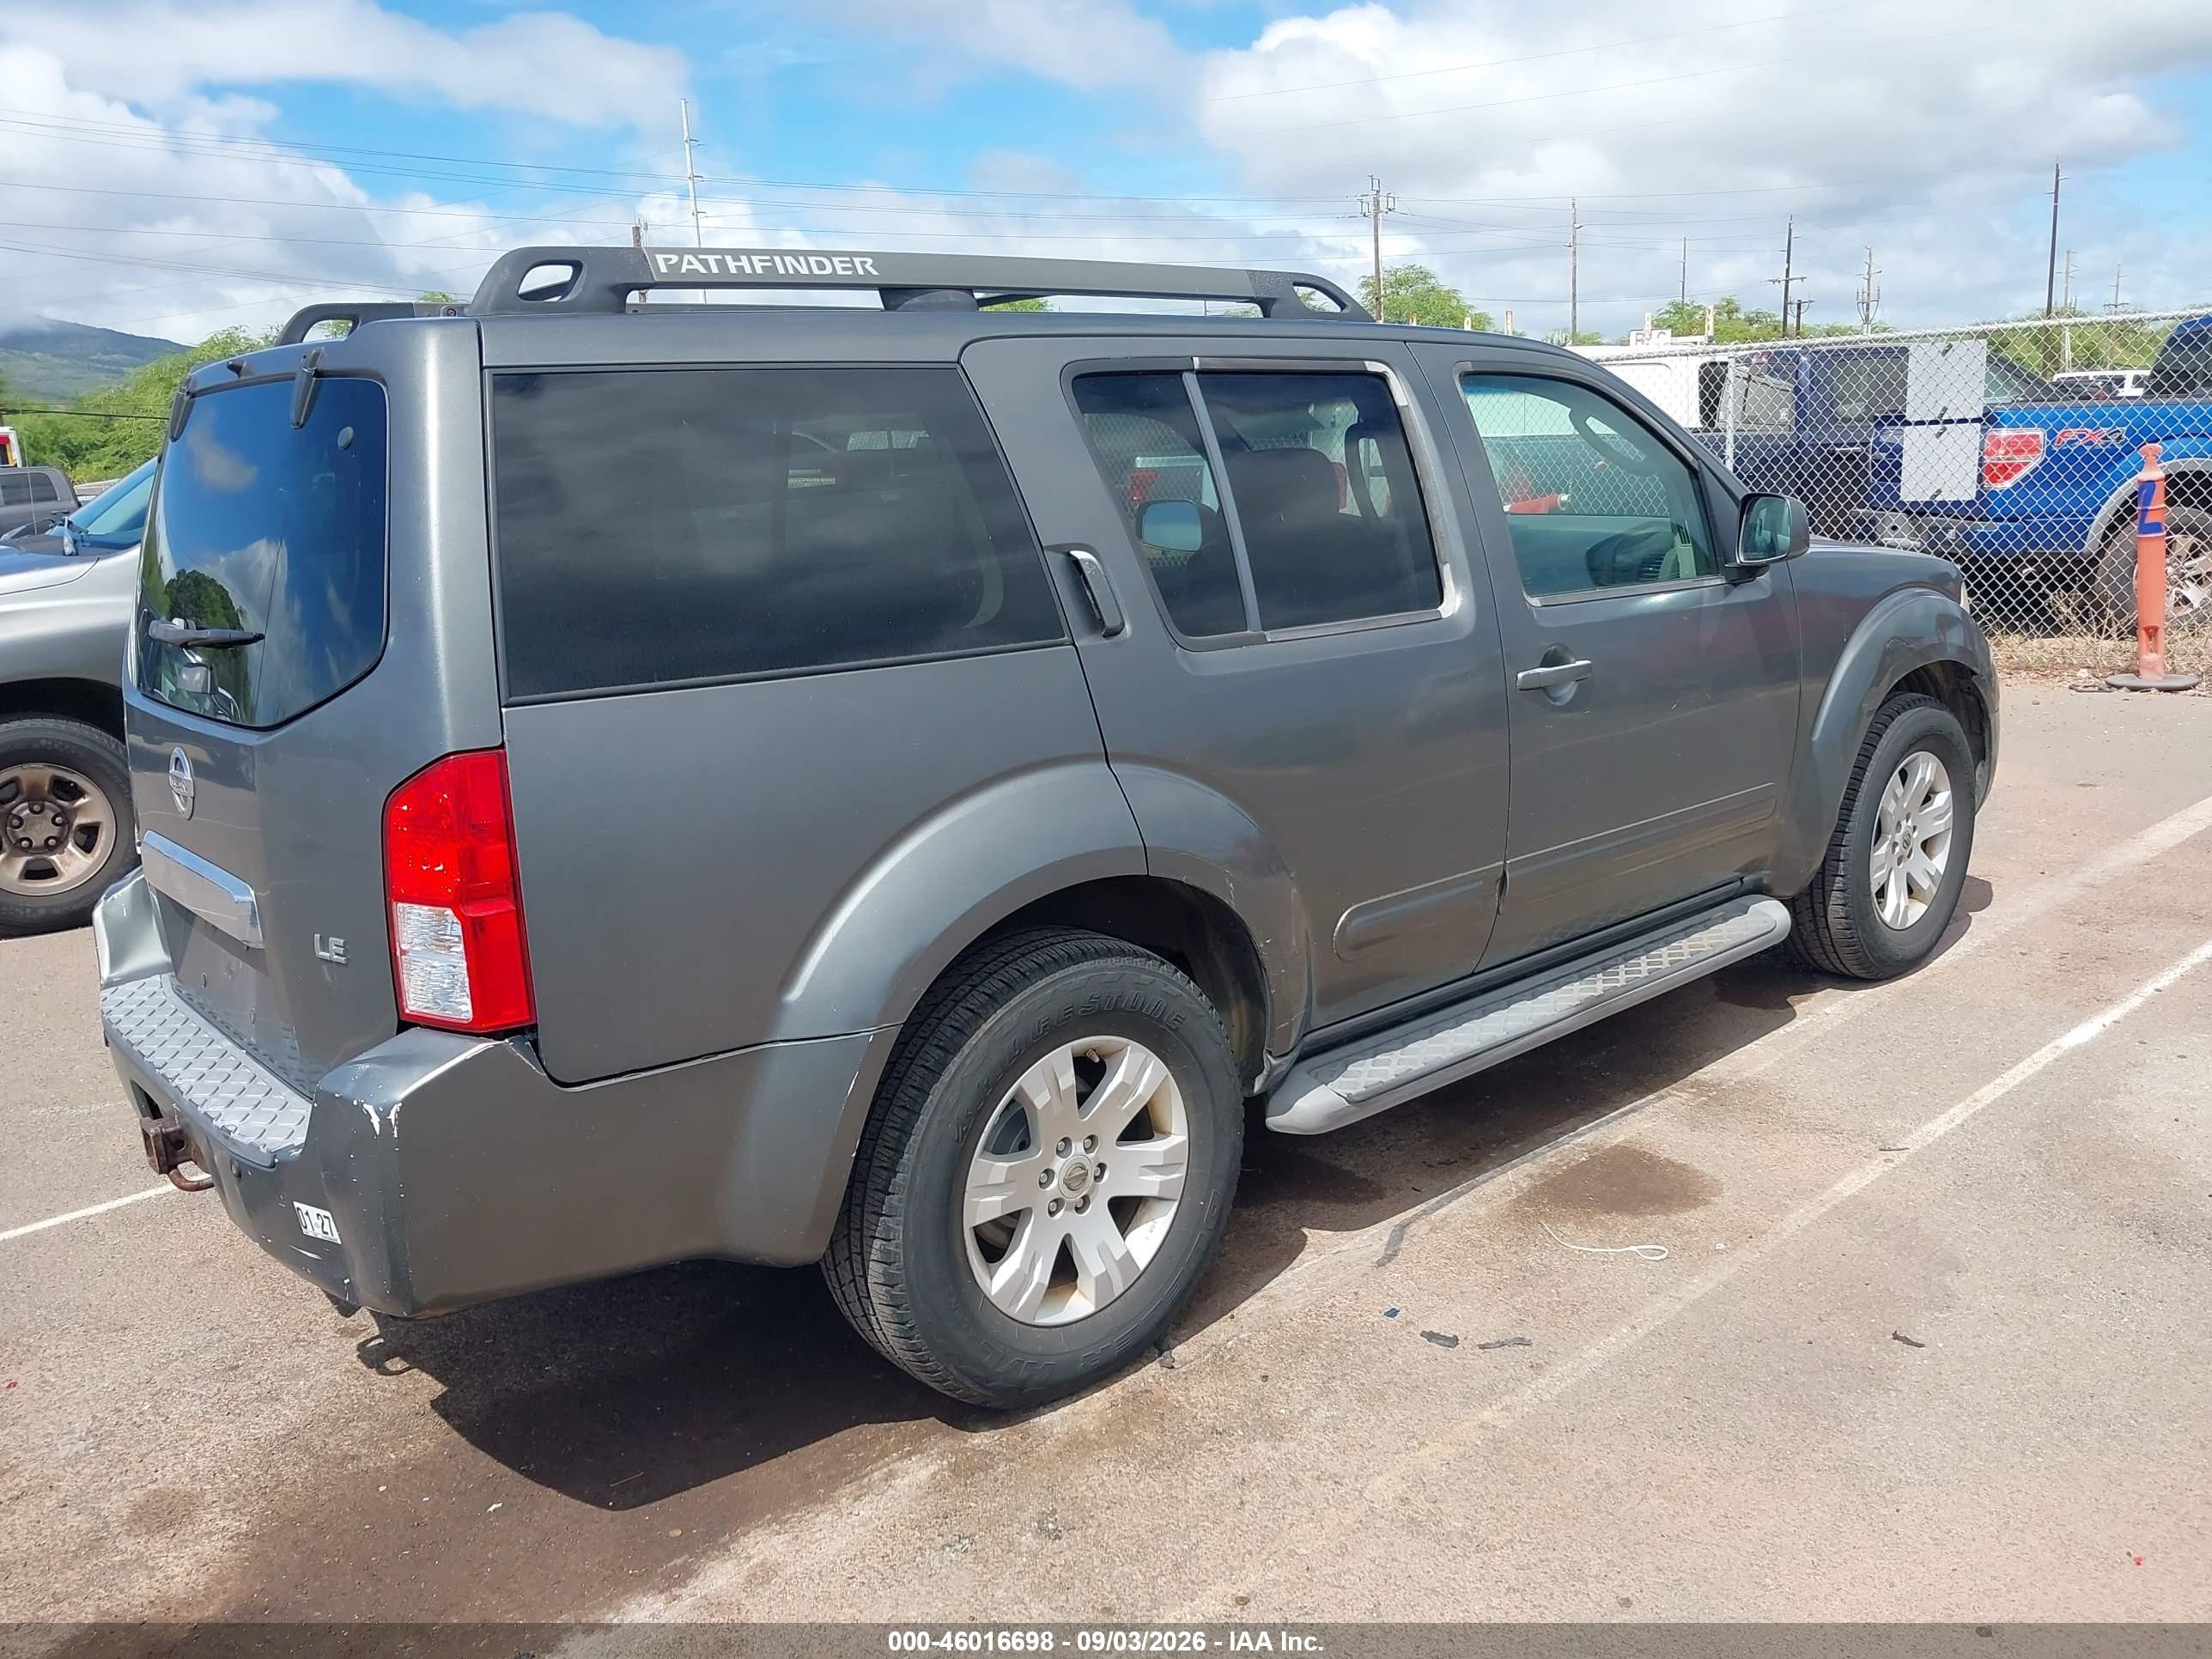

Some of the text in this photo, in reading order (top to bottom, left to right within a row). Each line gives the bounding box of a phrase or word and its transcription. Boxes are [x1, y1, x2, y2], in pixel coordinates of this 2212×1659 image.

[654, 253, 880, 276] PATHFINDER
[2054, 428, 2125, 447] FX4
[313, 933, 348, 963] LE
[296, 1206, 314, 1232] 01
[316, 1212, 334, 1237] 27
